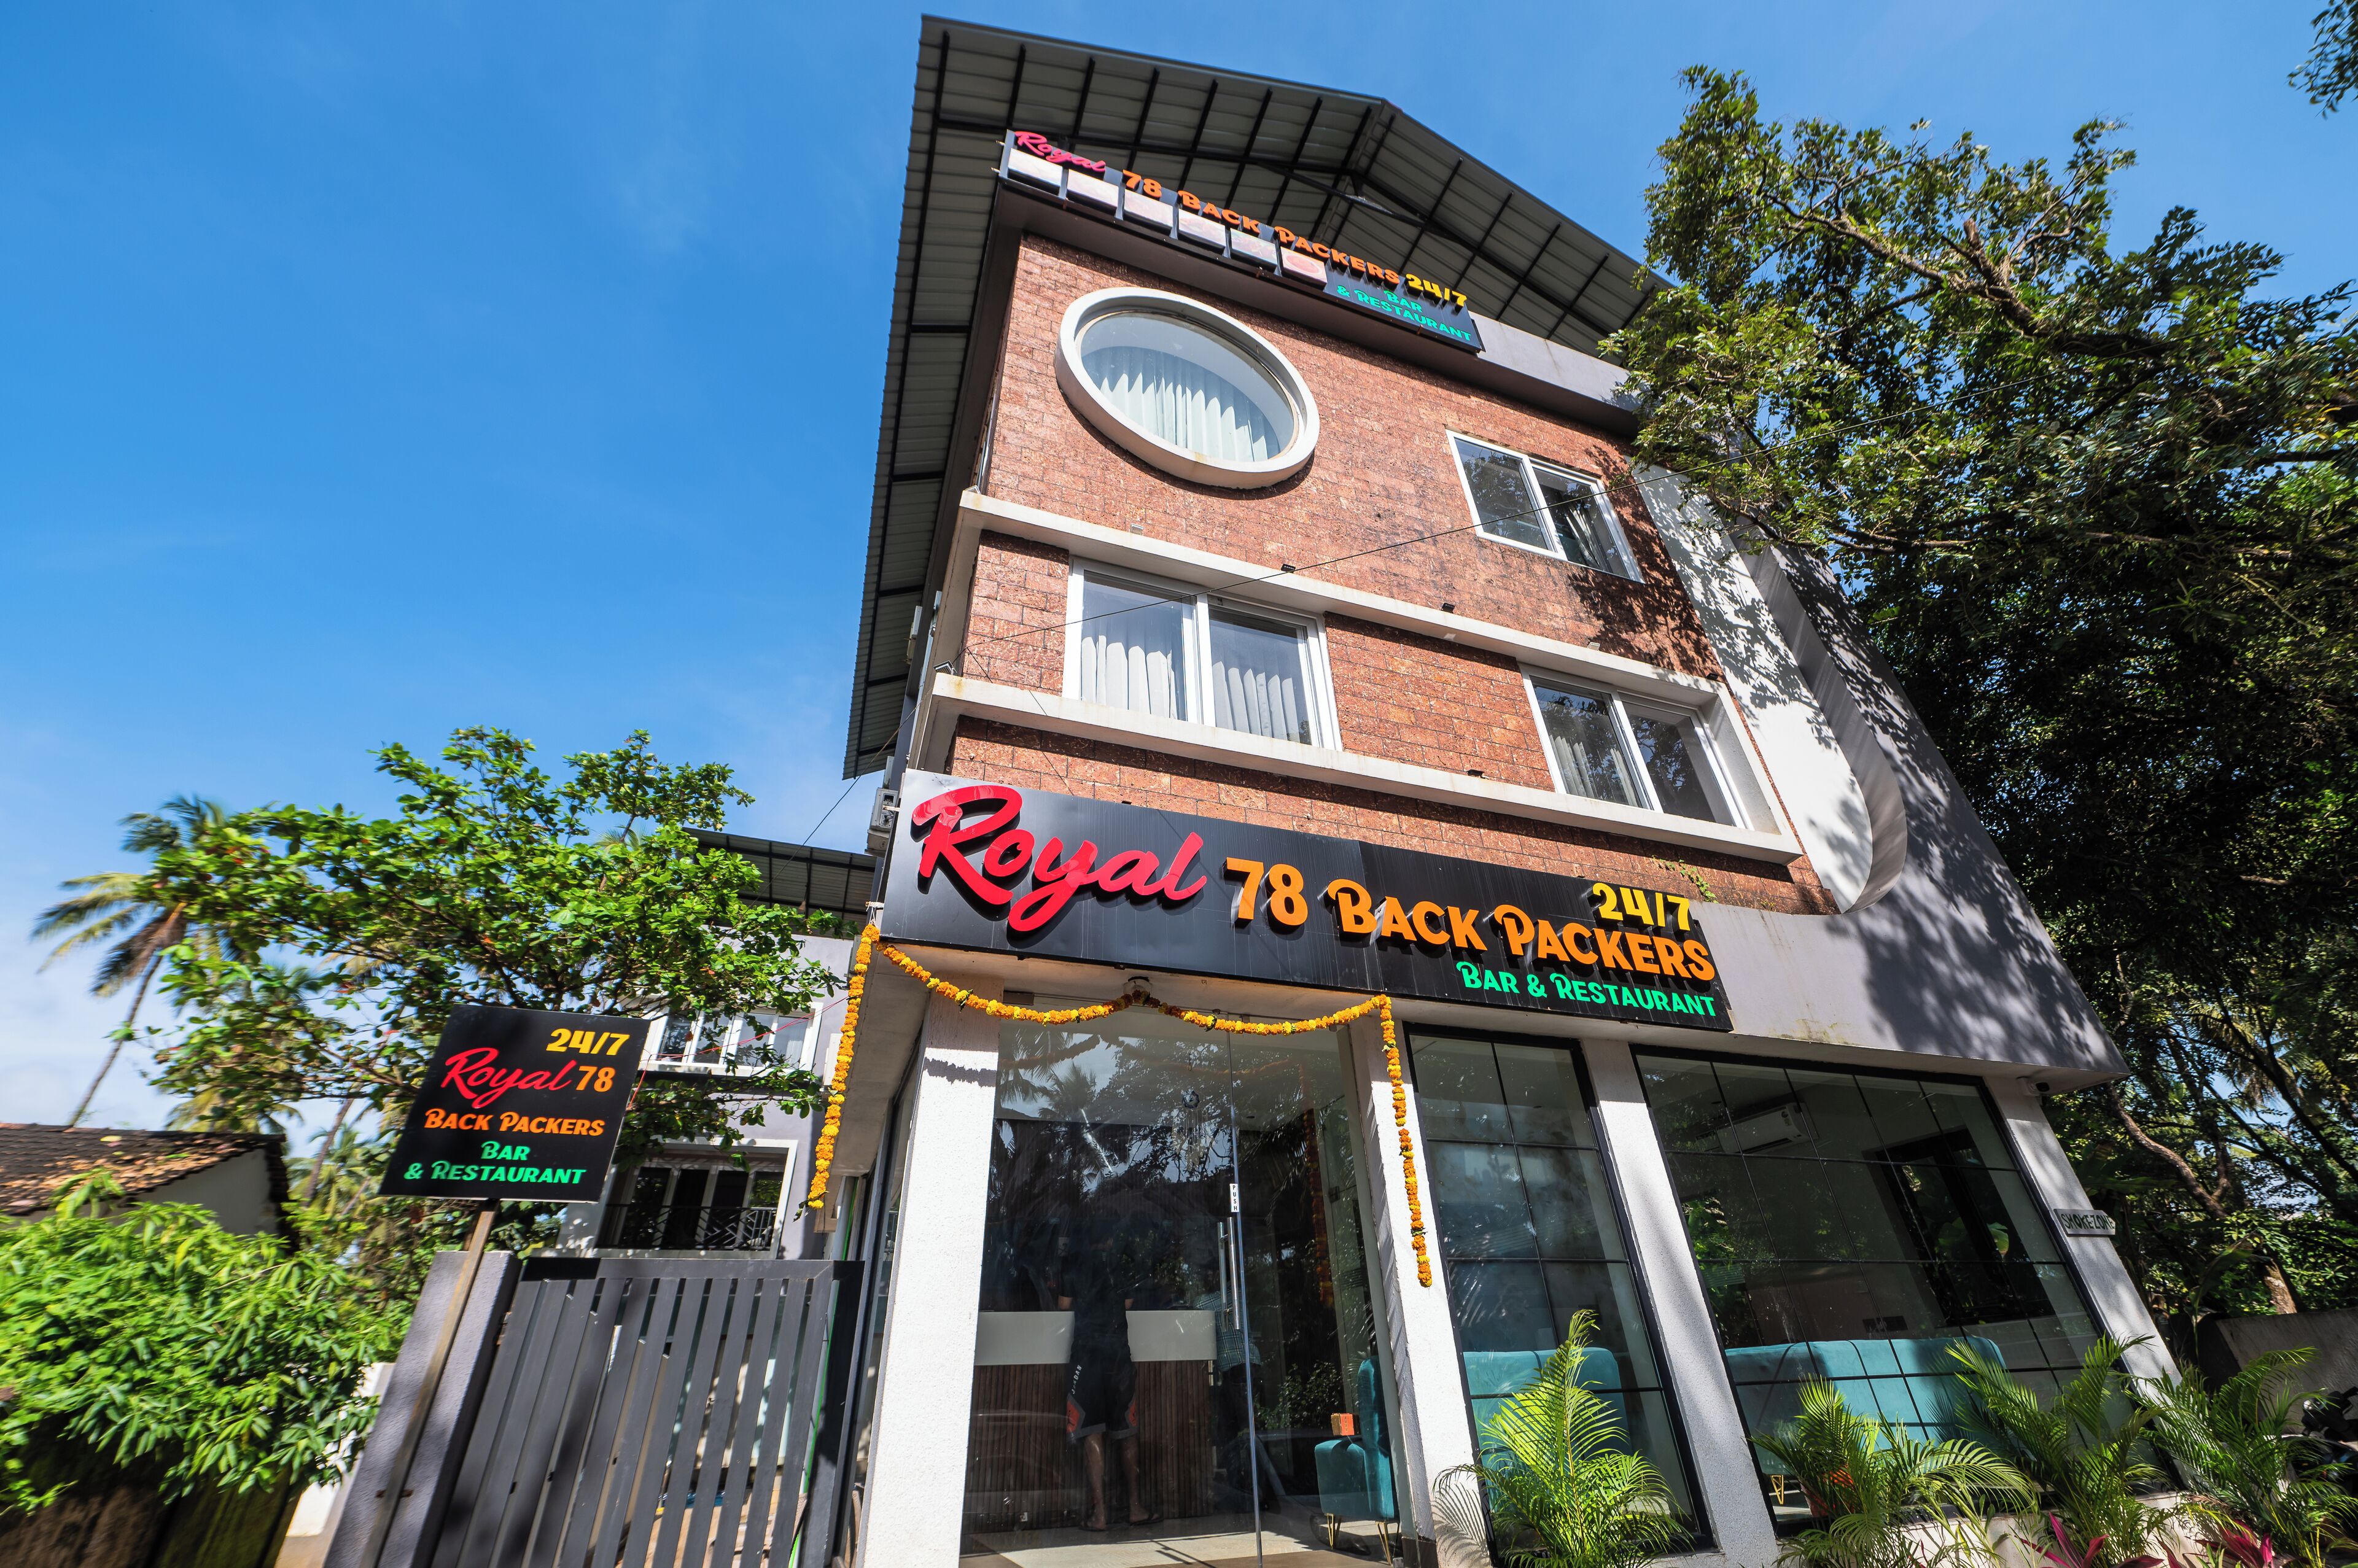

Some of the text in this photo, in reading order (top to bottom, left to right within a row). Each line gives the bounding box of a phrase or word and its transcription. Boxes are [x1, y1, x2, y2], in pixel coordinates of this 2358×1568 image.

[1014, 131, 1468, 307] Royal 78 BACK PACKERS 24/7
[1337, 285, 1471, 341] & RESTAURANT
[1383, 290, 1423, 312] BAR
[912, 785, 1715, 980] Royal 78 BACK PACKERS
[1592, 882, 1691, 931] 24/7
[1456, 961, 1717, 1017] BAR & RESTAURANT
[545, 1028, 630, 1056] 24/7
[440, 1047, 616, 1109] Royal 78
[424, 1108, 605, 1136] BACK PACKERS
[403, 1160, 586, 1184] & RESTAURANT
[481, 1141, 531, 1161] BAR
